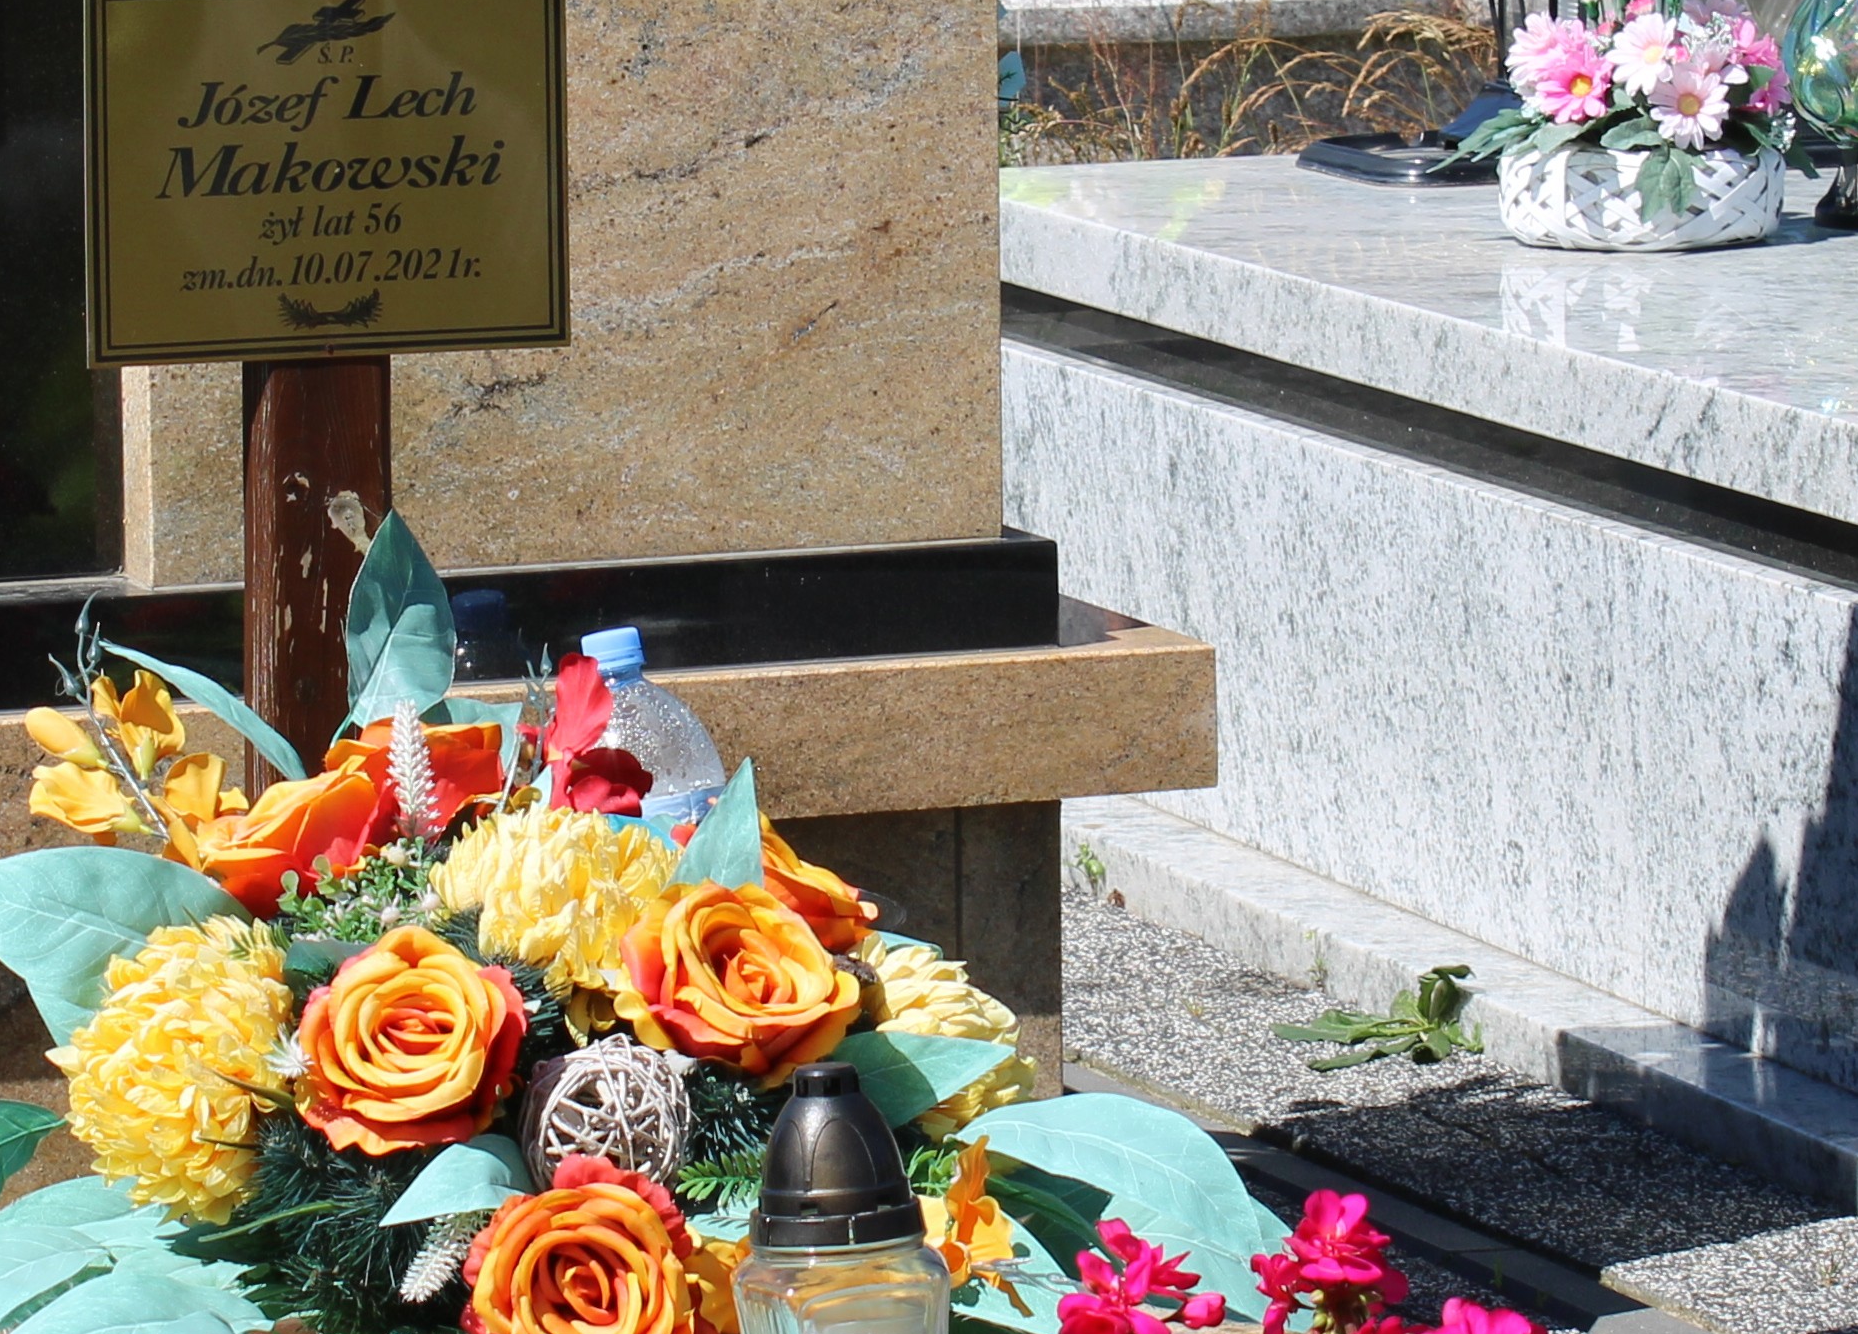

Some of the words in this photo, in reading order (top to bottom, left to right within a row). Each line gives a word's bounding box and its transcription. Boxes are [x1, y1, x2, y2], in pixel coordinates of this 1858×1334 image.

[339, 45, 354, 64] P.
[177, 75, 340, 133] Józef
[342, 71, 477, 120] Lech
[155, 134, 505, 200] Makowski
[258, 206, 304, 246] żył
[312, 205, 356, 238] lat
[364, 202, 403, 236] 56
